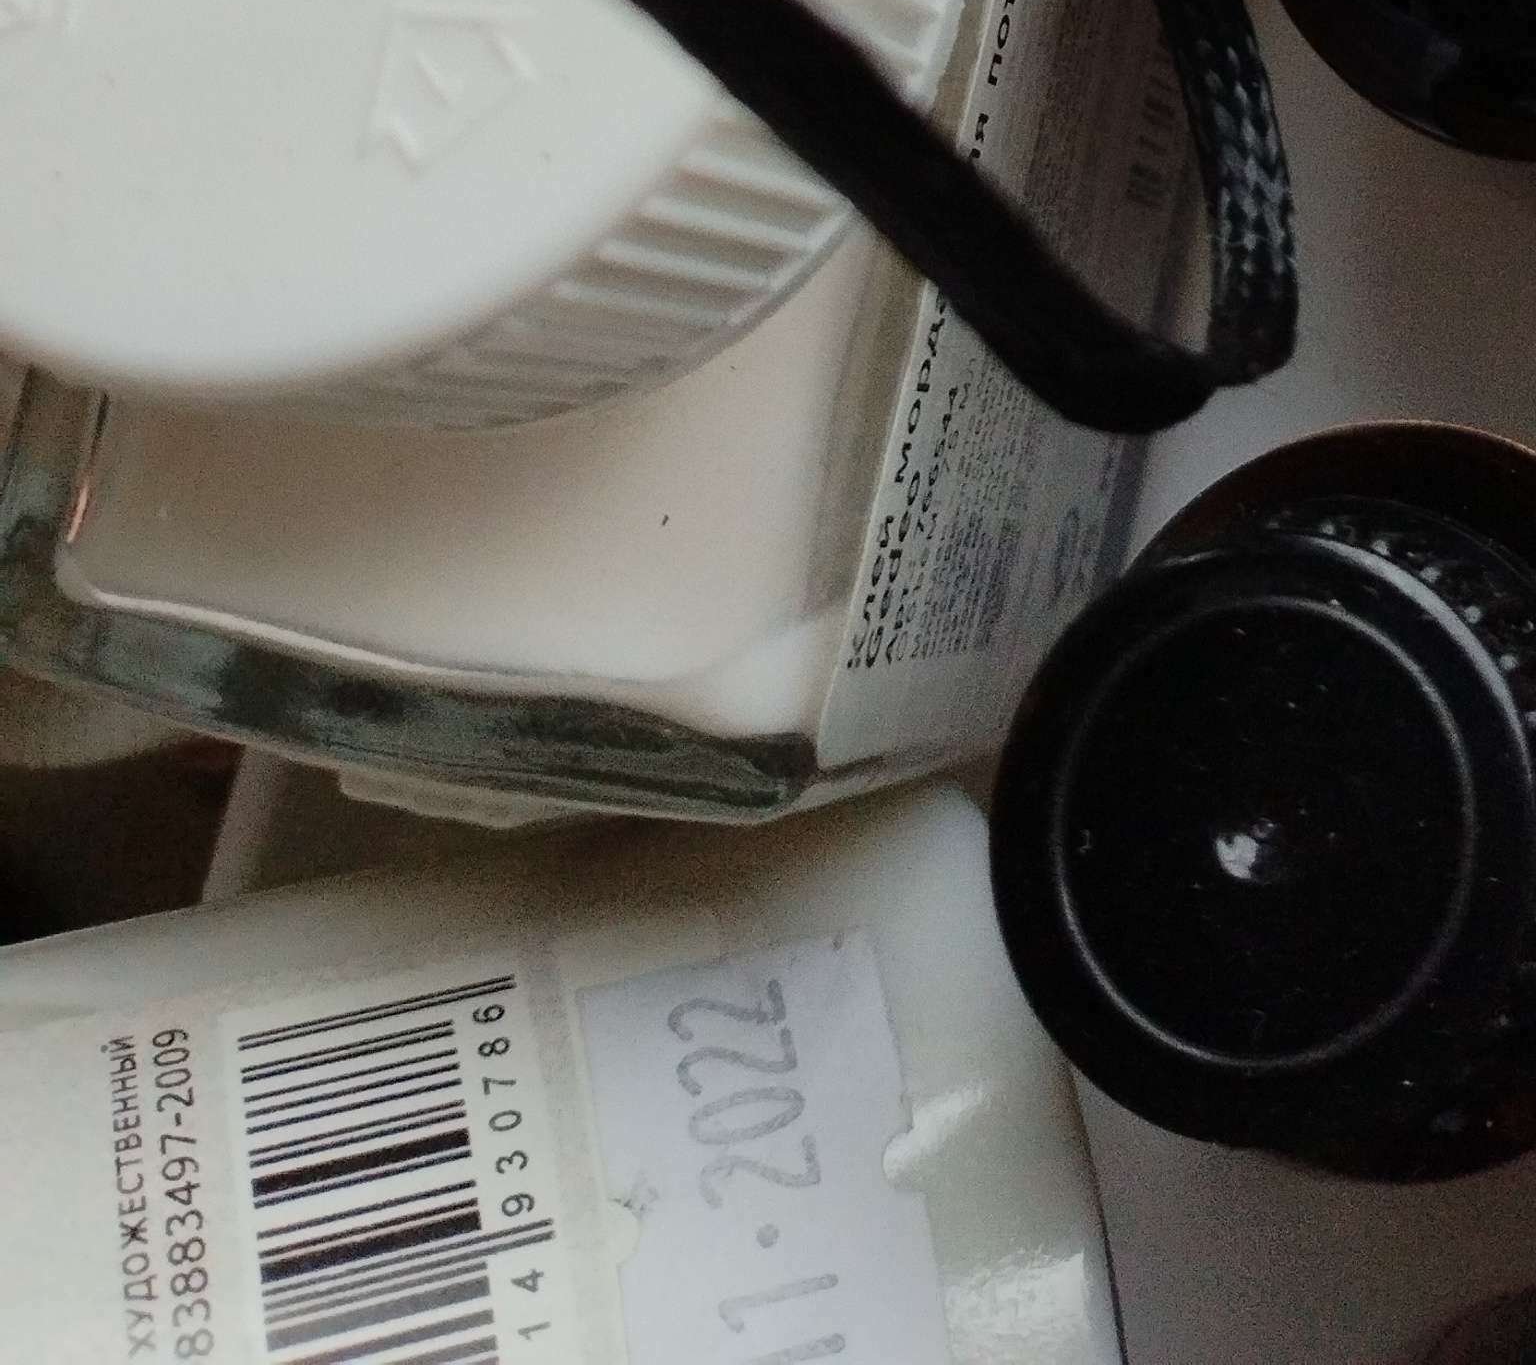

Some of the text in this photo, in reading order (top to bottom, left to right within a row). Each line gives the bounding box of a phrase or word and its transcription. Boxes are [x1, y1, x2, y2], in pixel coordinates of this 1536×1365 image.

[895, 285, 946, 483] морда
[865, 470, 921, 668] Gedeo
[100, 1034, 157, 1358] ХУДОЖЕСТВЕННЫЙ
[151, 1027, 215, 1360] 83883497-2009
